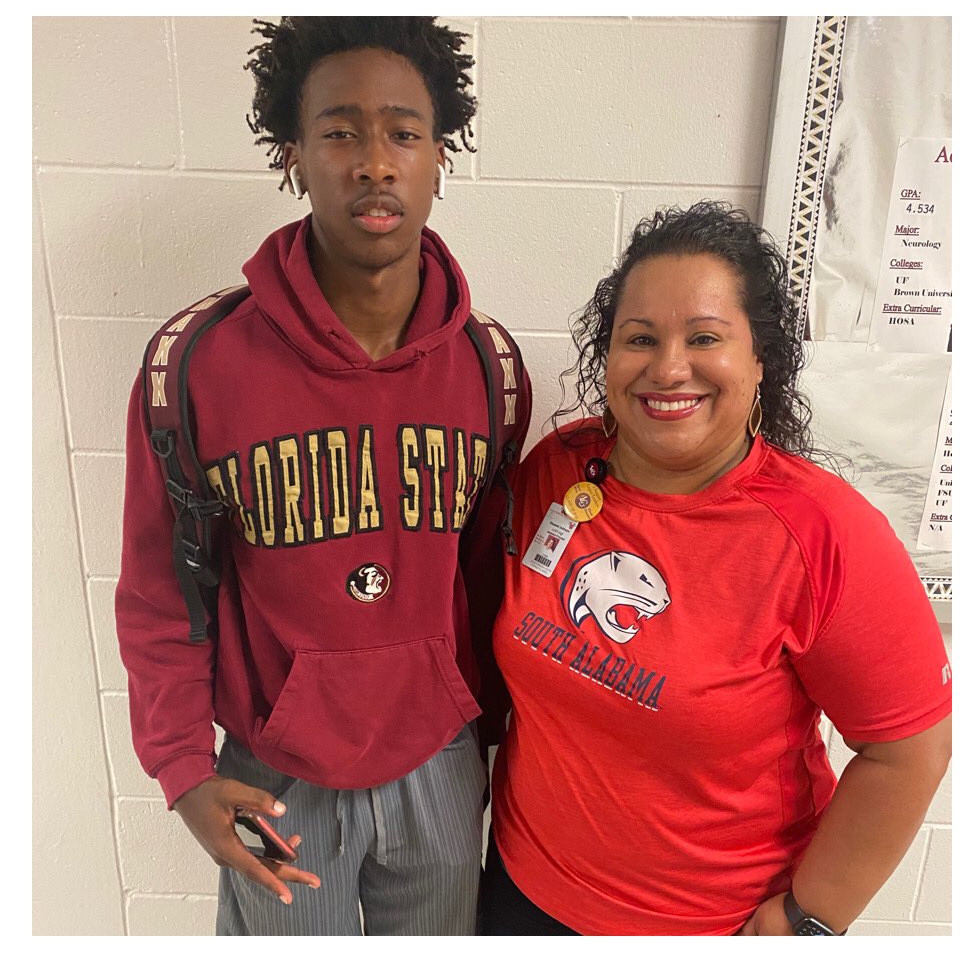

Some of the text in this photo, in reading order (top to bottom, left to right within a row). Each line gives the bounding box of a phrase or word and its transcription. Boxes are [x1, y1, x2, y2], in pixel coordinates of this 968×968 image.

[900, 189, 921, 199] GPA:
[906, 203, 935, 214] 4.534
[895, 224, 920, 235] Major:
[901, 238, 942, 250] Neurology
[889, 258, 924, 269] Colleges:
[895, 276, 910, 284] UF
[894, 288, 920, 296] Brown
[882, 303, 942, 313] Extra Curricular:
[204, 423, 489, 549] FLORIDA STAT
[513, 611, 667, 712] SOUTH ALABAMA
